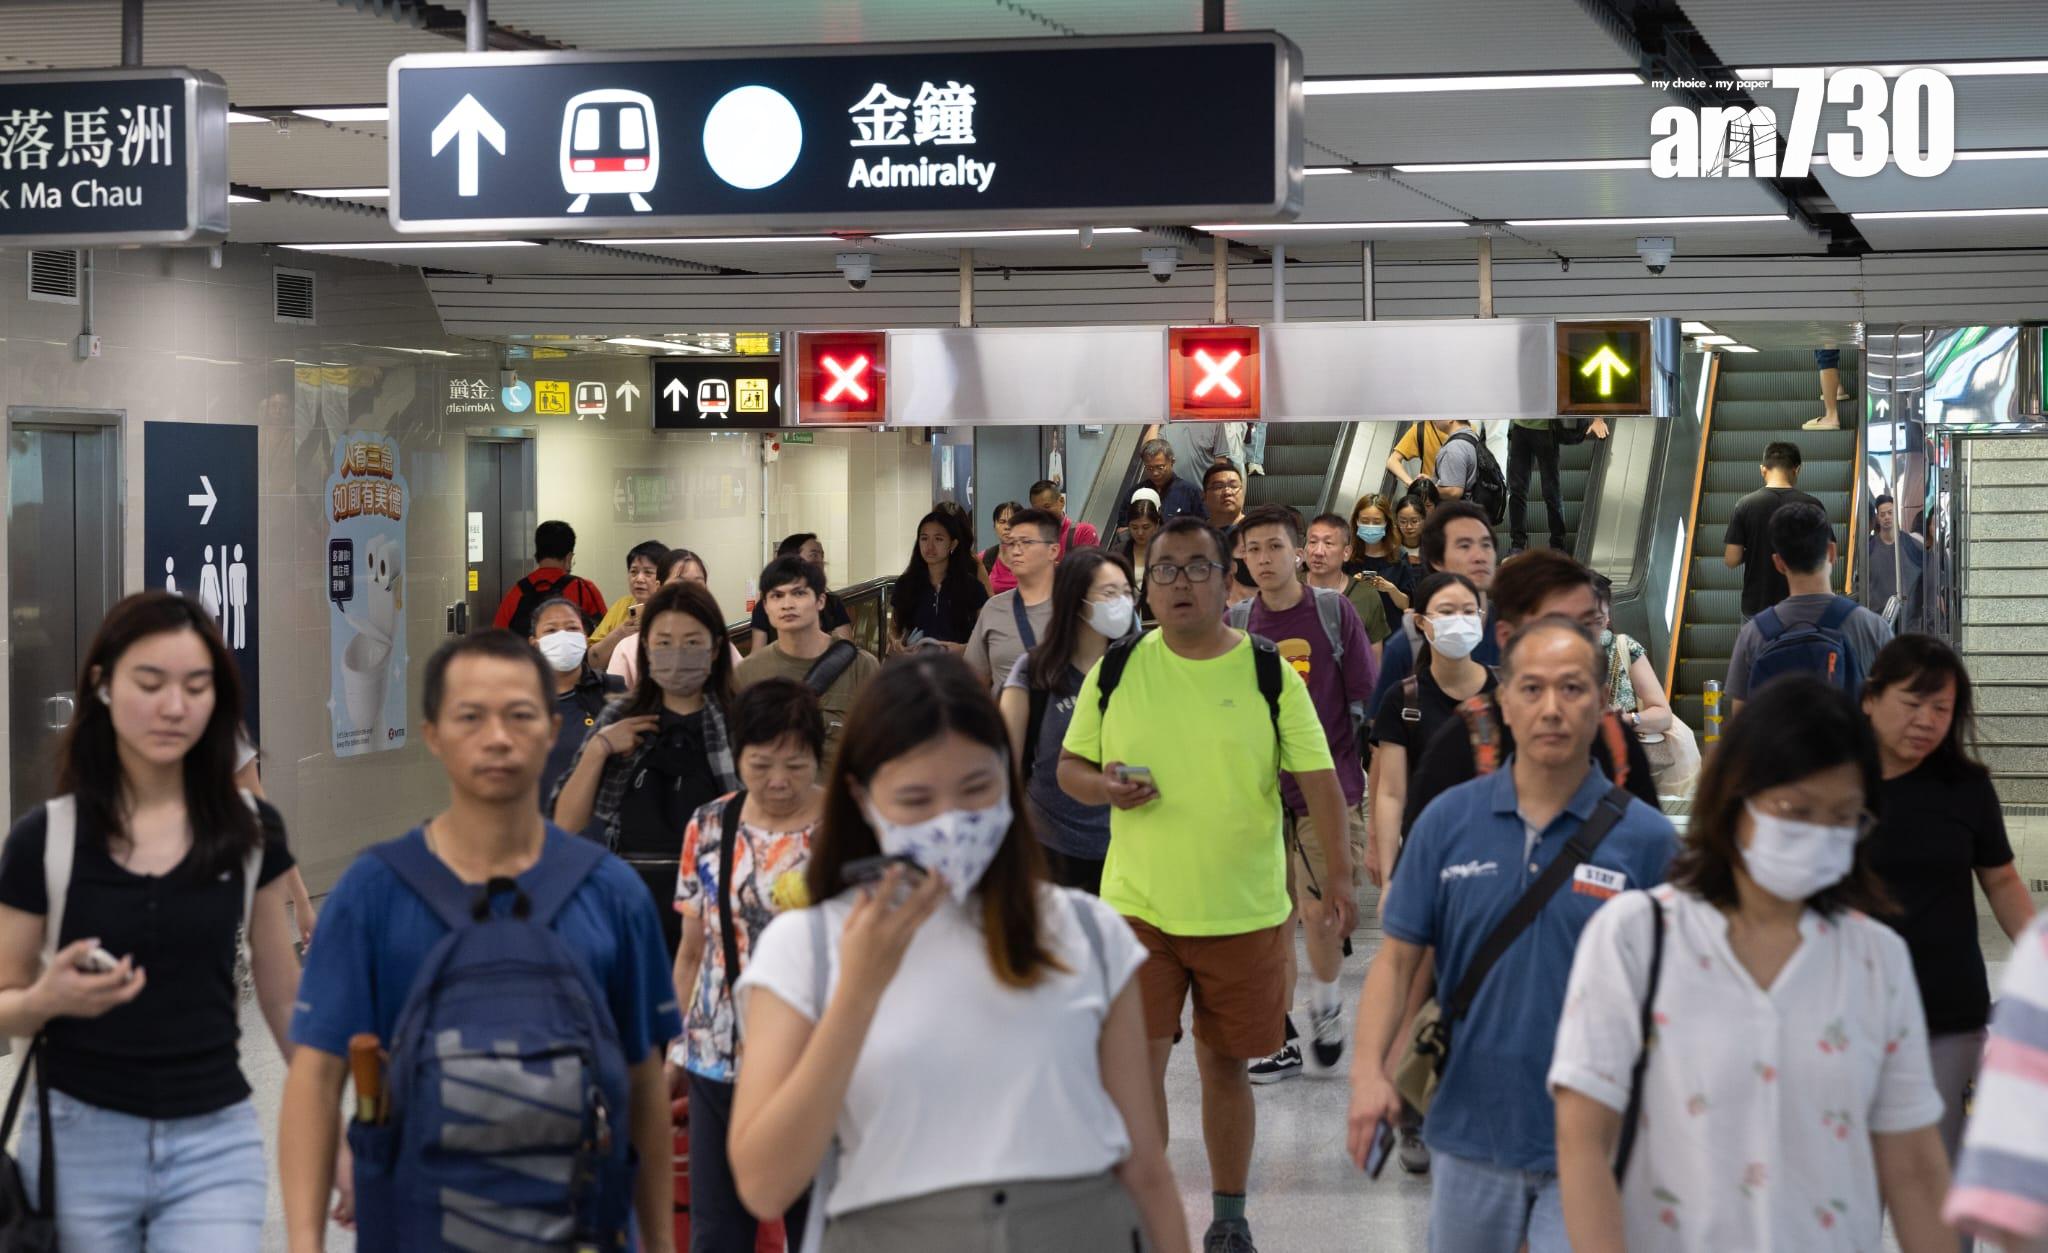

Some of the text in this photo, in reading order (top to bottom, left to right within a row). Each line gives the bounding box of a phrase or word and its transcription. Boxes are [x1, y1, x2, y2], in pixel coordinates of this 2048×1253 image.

[848, 80, 977, 146] 金鐘
[0, 104, 172, 170] 落馬洲
[848, 155, 997, 193] Admiralty
[20, 182, 62, 209] Ma
[71, 179, 142, 207] Chau
[341, 442, 393, 478] 人有三急
[1585, 868, 1616, 885] STAY
